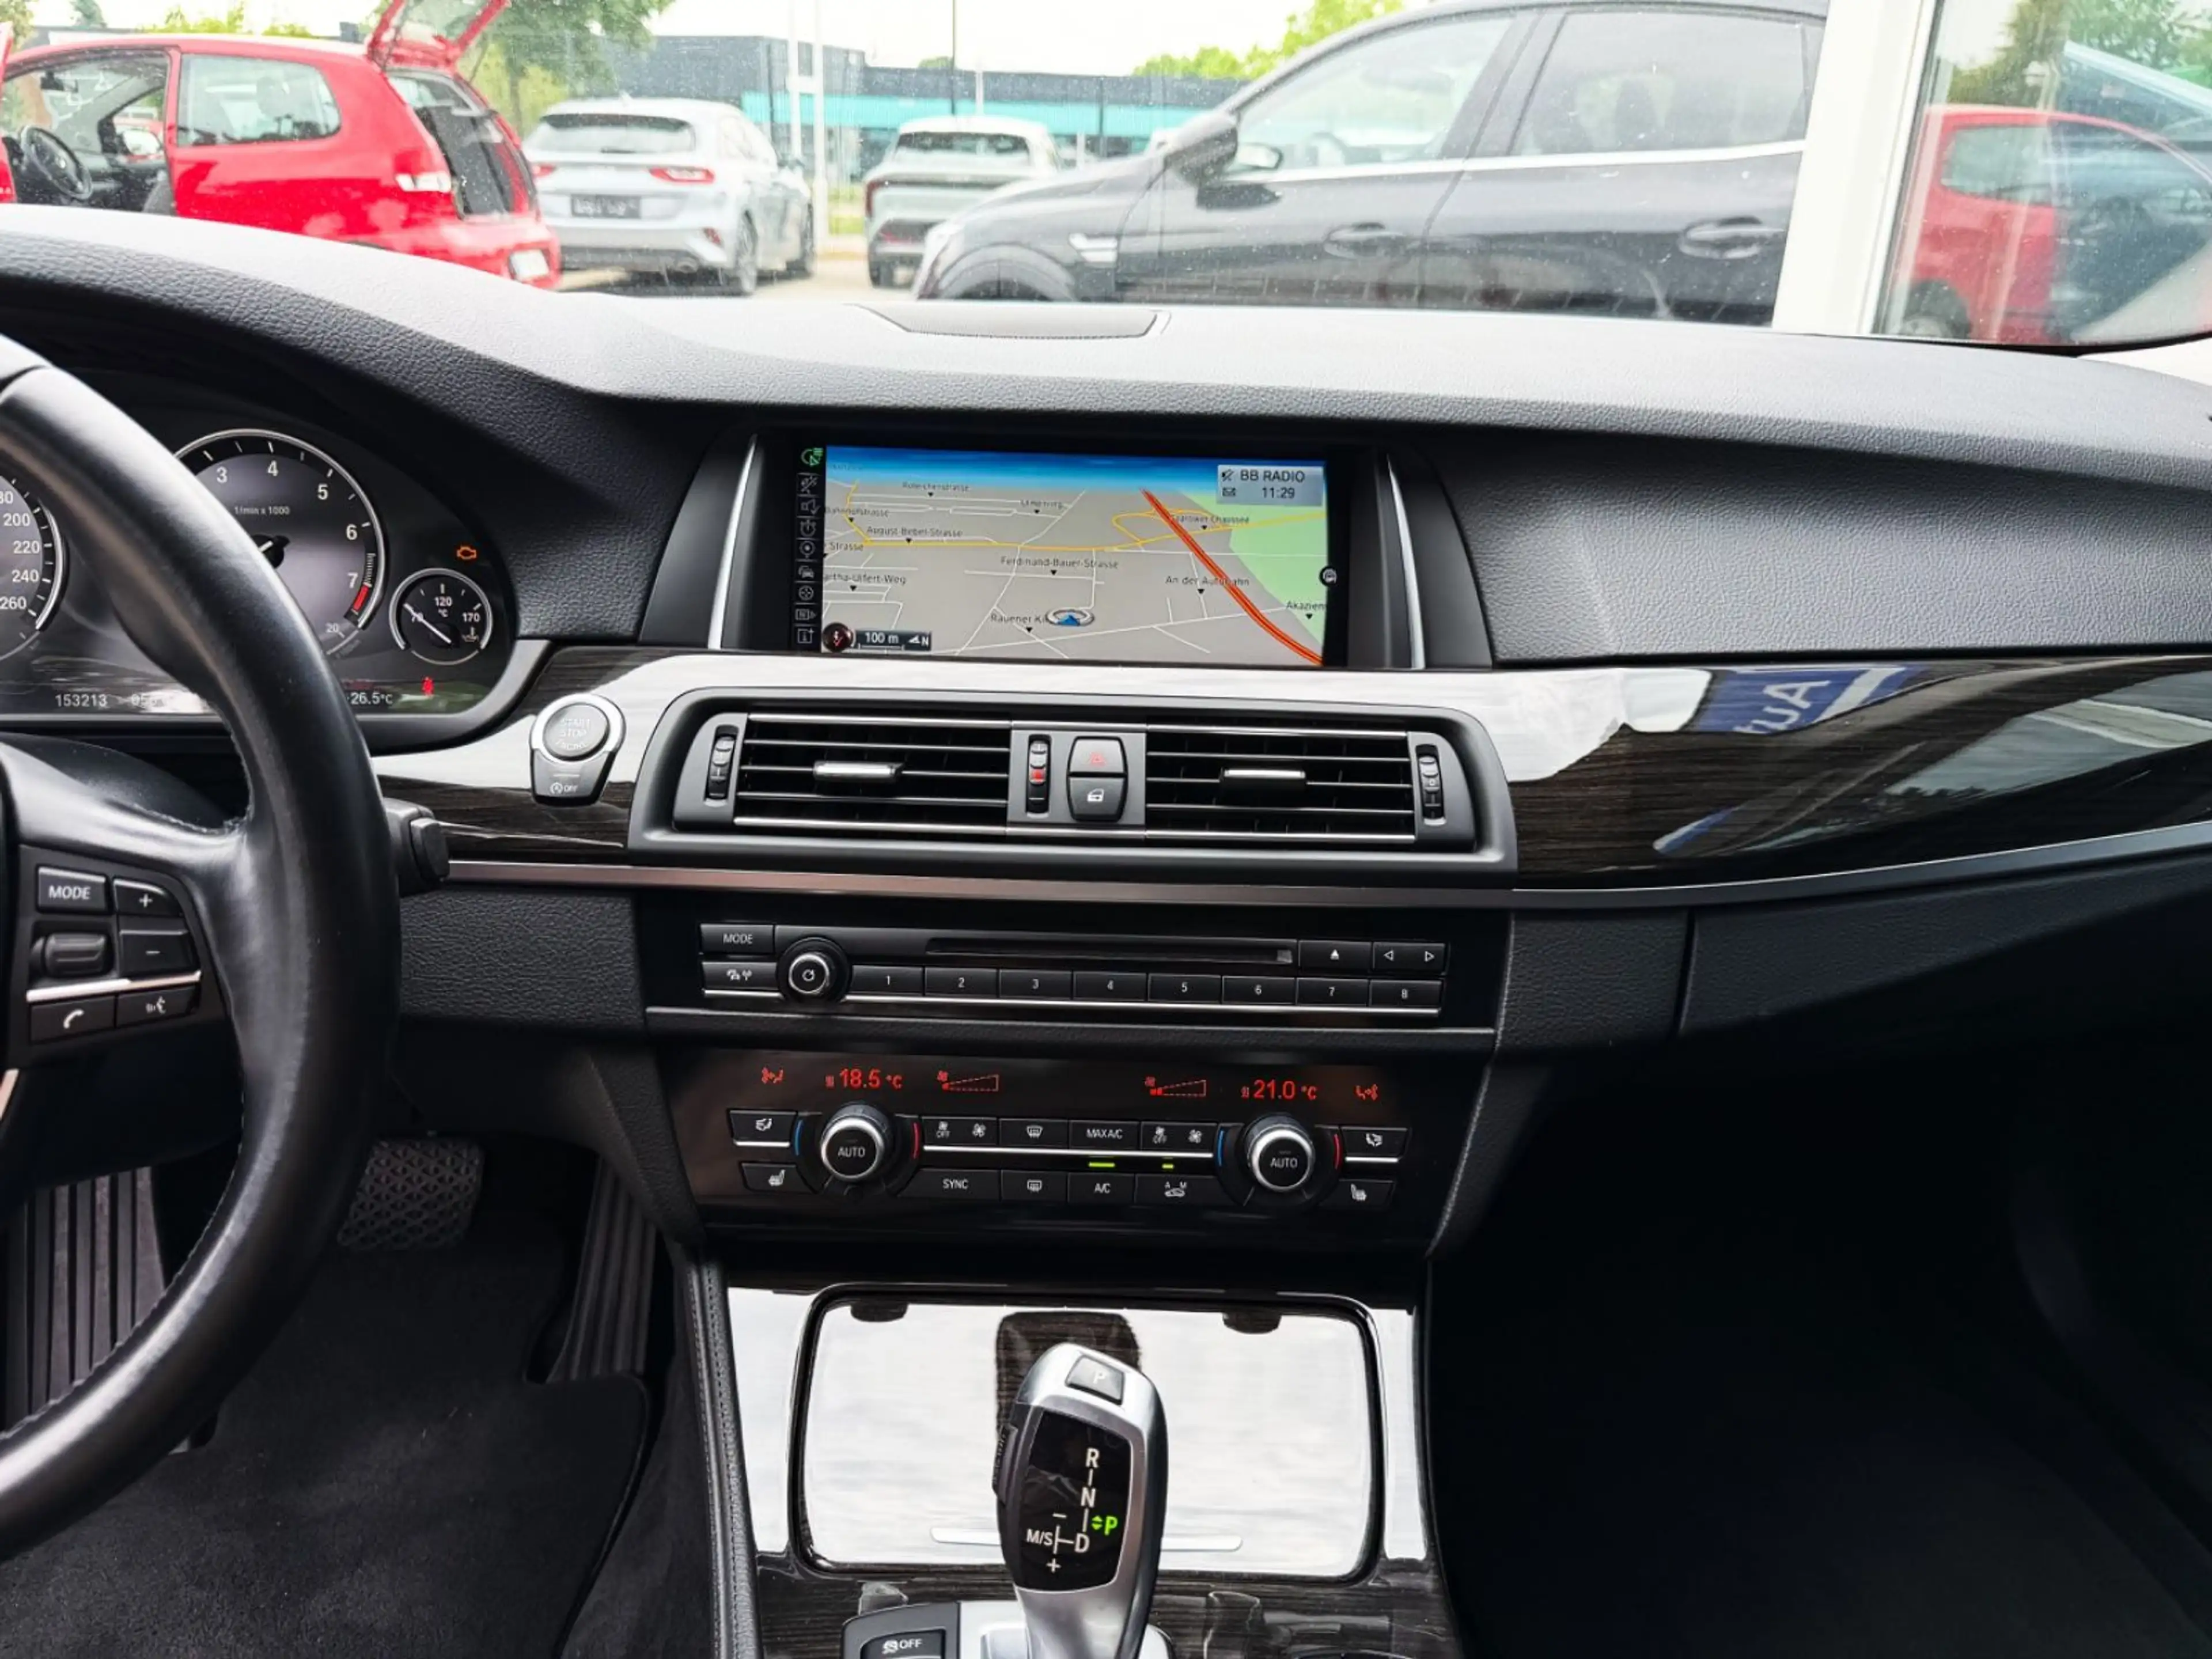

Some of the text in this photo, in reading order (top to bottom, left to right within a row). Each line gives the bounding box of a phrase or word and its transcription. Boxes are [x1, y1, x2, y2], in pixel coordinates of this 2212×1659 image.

[267, 461, 279, 476] 4
[216, 467, 228, 483] 3
[1240, 469, 1305, 483] BB RADIO
[317, 483, 328, 500] 5
[1262, 487, 1296, 499] 11:29
[234, 506, 259, 515] 1/min
[268, 506, 290, 514] 1000
[3, 513, 30, 527] 200
[346, 524, 358, 540] 6
[13, 540, 40, 554] 220
[12, 570, 39, 583] 240
[348, 572, 358, 589] 7
[1165, 575, 1179, 584] An
[1181, 575, 1198, 585] der
[0, 596, 26, 609] 260
[434, 596, 453, 607] 120
[463, 612, 480, 623] 170
[991, 614, 1032, 624] Rauener
[865, 632, 899, 643] 100 m
[922, 637, 929, 646] N
[55, 694, 108, 707] 153213
[48, 885, 90, 900] MODE
[723, 933, 753, 944] MODE
[887, 975, 891, 985] 1
[958, 978, 965, 988] 2
[1032, 979, 1039, 989] 3
[1107, 980, 1114, 990] 4
[1181, 982, 1187, 992] 5
[1255, 984, 1262, 995] 6
[1328, 987, 1335, 997] 7
[1401, 988, 1408, 999] 8
[839, 1069, 881, 1089] 18.5
[1253, 1079, 1296, 1100] 21.0
[936, 1130, 951, 1139] OFF
[1086, 1128, 1123, 1139] MAX A/C
[837, 1146, 866, 1158] AUTO
[1270, 1157, 1298, 1169] AUTO
[942, 1179, 969, 1190] SYNC
[1094, 1183, 1111, 1194] A/C
[1165, 1181, 1171, 1189] A
[1093, 1369, 1106, 1384] P
[1085, 1448, 1100, 1468] R
[1080, 1487, 1096, 1508] N
[1104, 1516, 1118, 1536] P
[1026, 1528, 1090, 1553] M/S D
[899, 1638, 923, 1649] OFF
